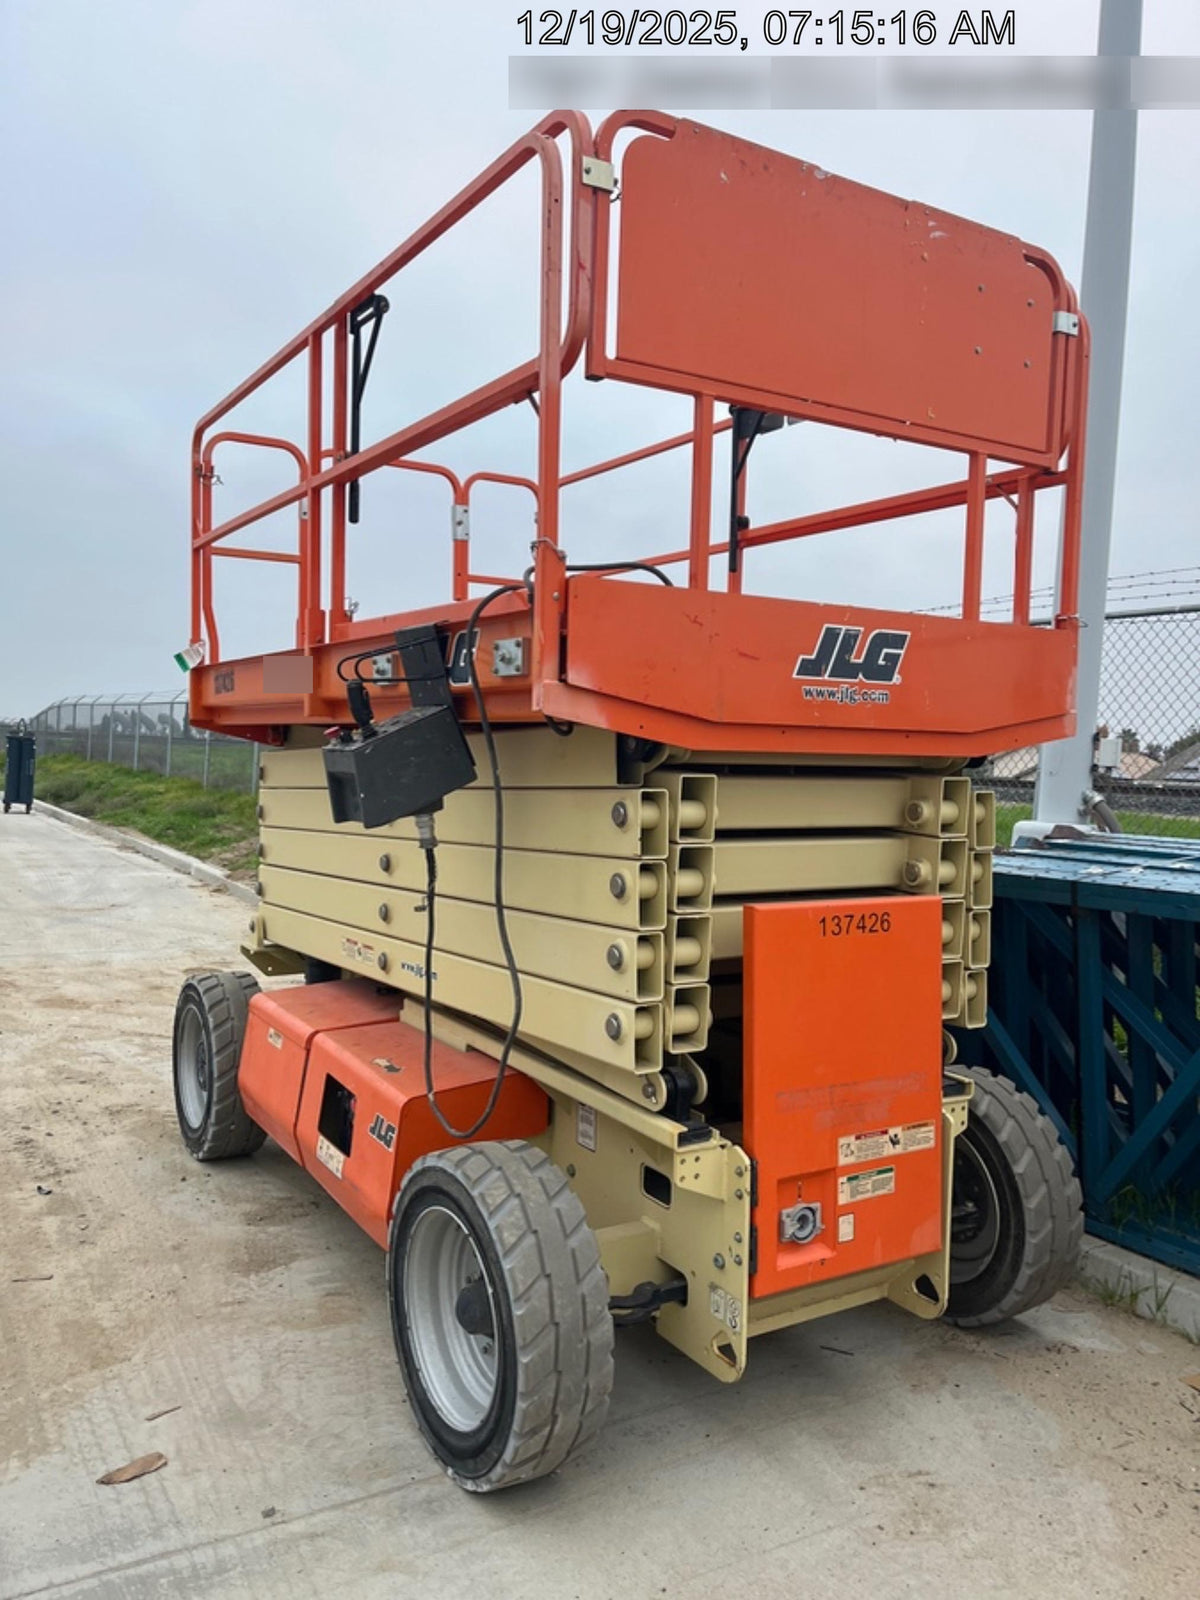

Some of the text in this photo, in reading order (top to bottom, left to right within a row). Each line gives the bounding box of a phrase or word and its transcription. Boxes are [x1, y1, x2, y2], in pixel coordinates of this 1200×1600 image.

[793, 624, 910, 684] JLG
[803, 686, 889, 703] www.jlg.com
[819, 911, 891, 937] 137426
[368, 1112, 398, 1152] JLG
